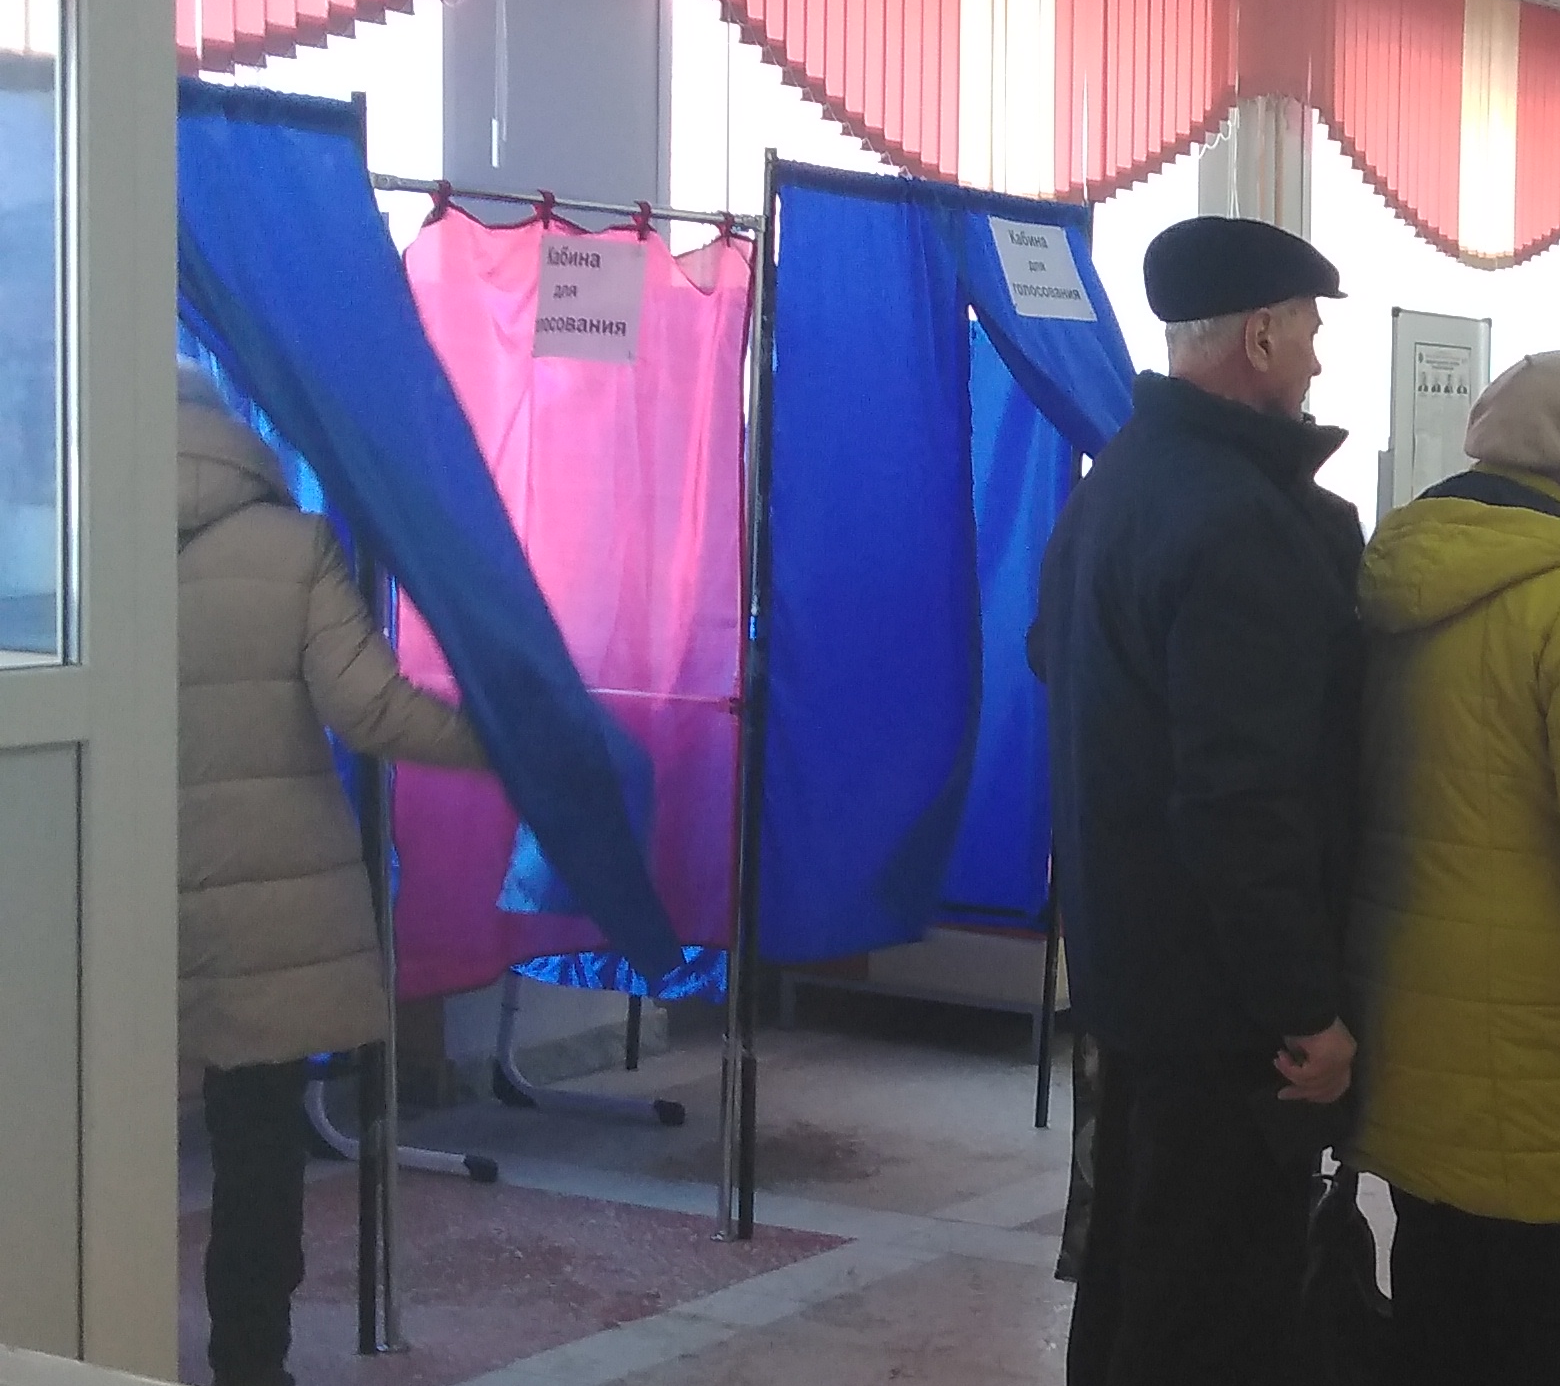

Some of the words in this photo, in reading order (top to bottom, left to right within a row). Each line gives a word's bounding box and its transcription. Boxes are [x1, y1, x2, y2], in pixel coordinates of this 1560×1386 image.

[1009, 229, 1049, 249] Кабина
[1028, 260, 1046, 272] для
[553, 284, 577, 299] для
[1013, 283, 1081, 301] голосования
